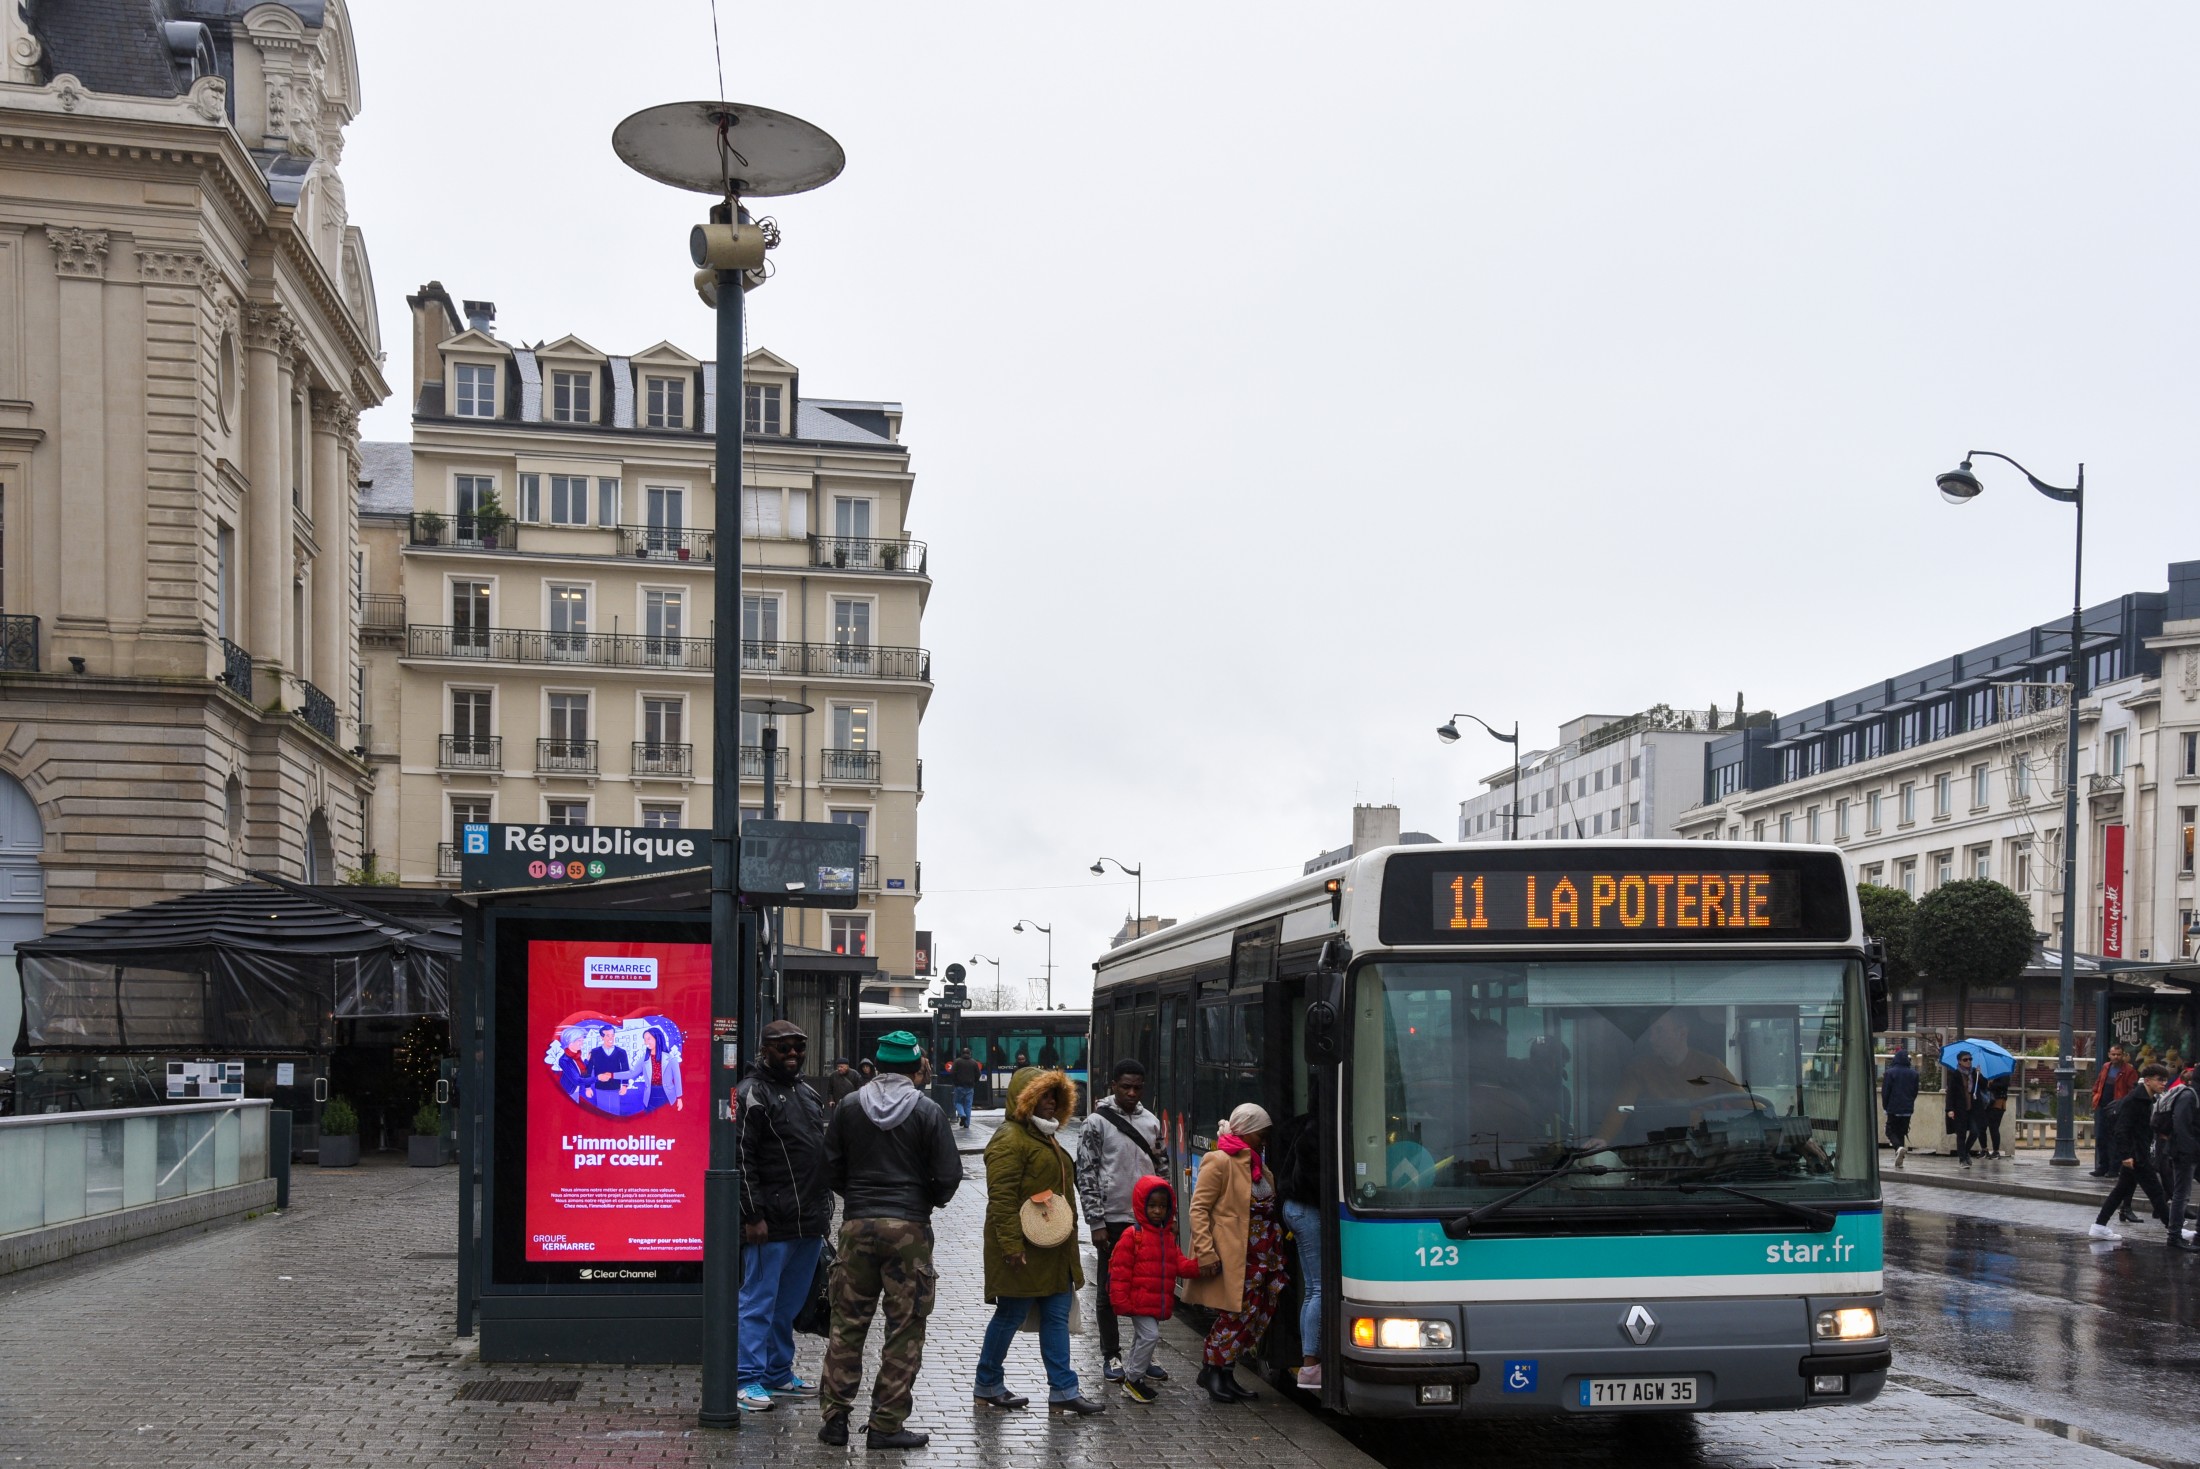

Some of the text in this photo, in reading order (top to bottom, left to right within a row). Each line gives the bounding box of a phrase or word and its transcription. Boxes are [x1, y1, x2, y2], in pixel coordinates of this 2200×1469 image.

[468, 833, 485, 854] B
[505, 826, 695, 863] République
[531, 864, 603, 876] 11 54 55 56
[1450, 875, 1770, 928] 11 LA POTERIE
[590, 963, 652, 973] KERMARREC
[562, 1135, 676, 1150] L'immobilier
[574, 1154, 663, 1169] par cœur.
[533, 1234, 567, 1243] GROUPE
[542, 1242, 596, 1251] KERMARREC
[1766, 1235, 1855, 1263] star.fr
[1414, 1246, 1459, 1266] 123
[593, 1269, 657, 1279] Clear Channel
[1594, 1382, 1692, 1402] 717 AGW 35
